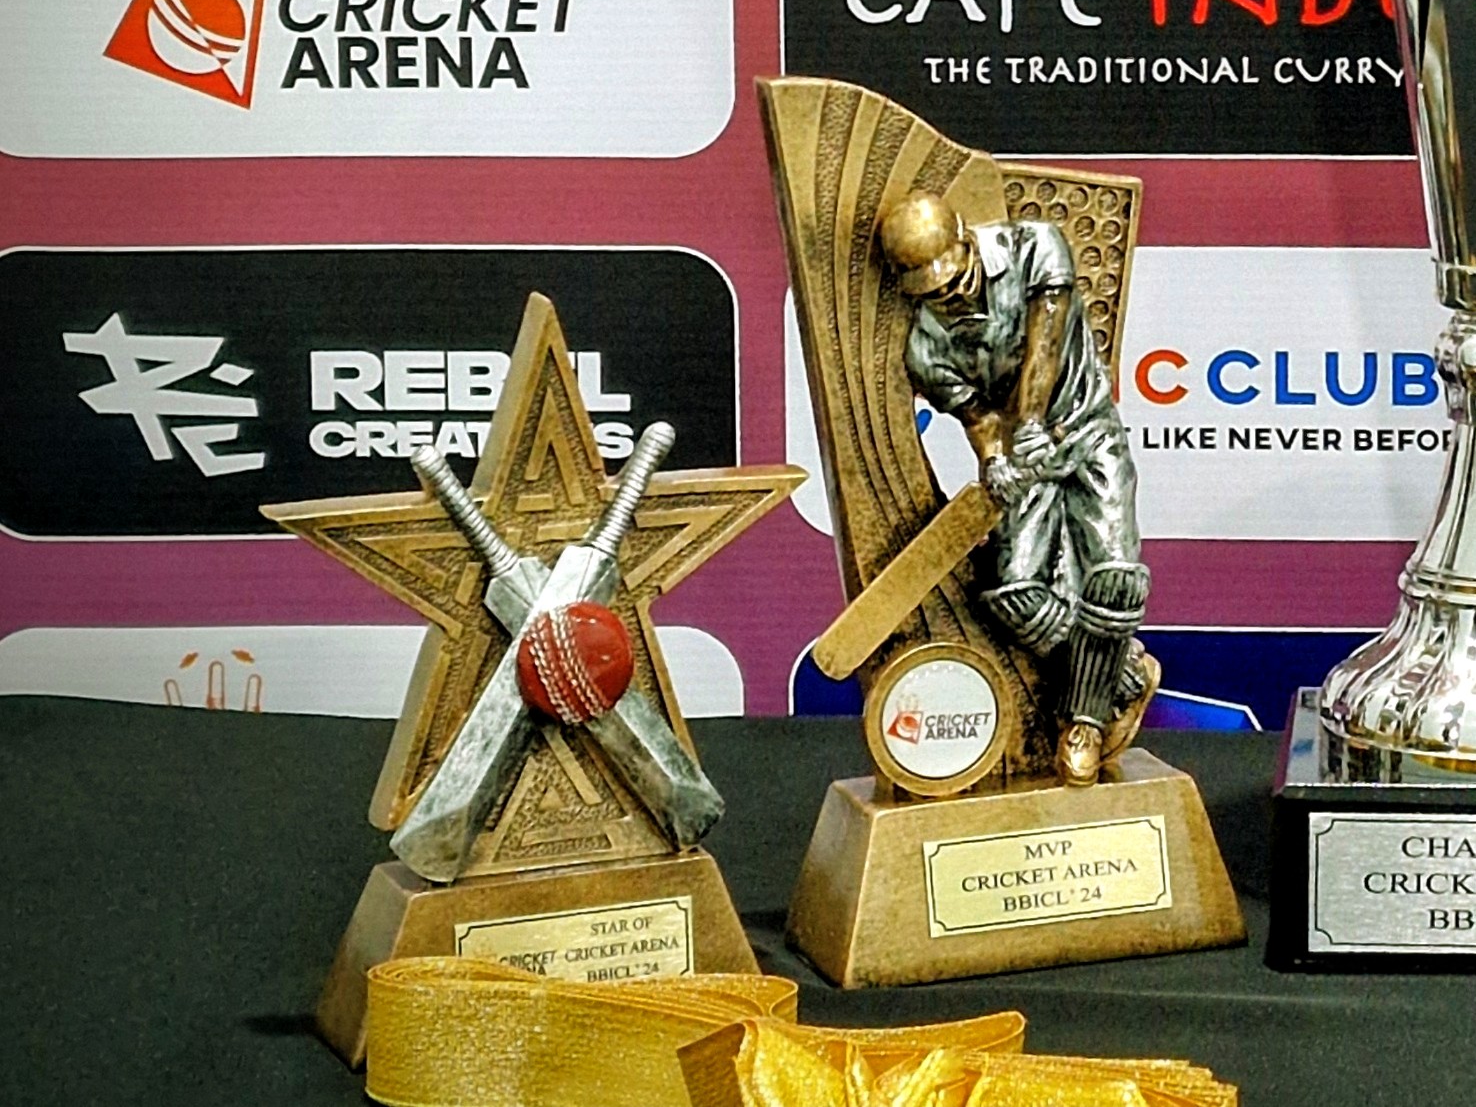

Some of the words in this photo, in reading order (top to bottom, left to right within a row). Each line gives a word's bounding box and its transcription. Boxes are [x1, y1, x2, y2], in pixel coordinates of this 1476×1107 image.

[281, 36, 530, 89] ARENA
[924, 56, 991, 84] THE
[1005, 56, 1258, 84] TRADITIONAL
[1274, 56, 1404, 88] CURRY
[310, 351, 631, 411] REBL
[1142, 427, 1217, 449] LIKE
[1229, 428, 1342, 451] NEVER
[925, 712, 992, 727] CRICKET
[925, 727, 978, 741] ARENA
[1024, 840, 1072, 861] MVP
[961, 867, 1058, 894] CRICKET
[1063, 858, 1138, 882] ARENA
[590, 919, 628, 936] STAR
[633, 916, 653, 930] OF
[564, 942, 627, 963] CRICKET
[630, 936, 680, 954] ARENA
